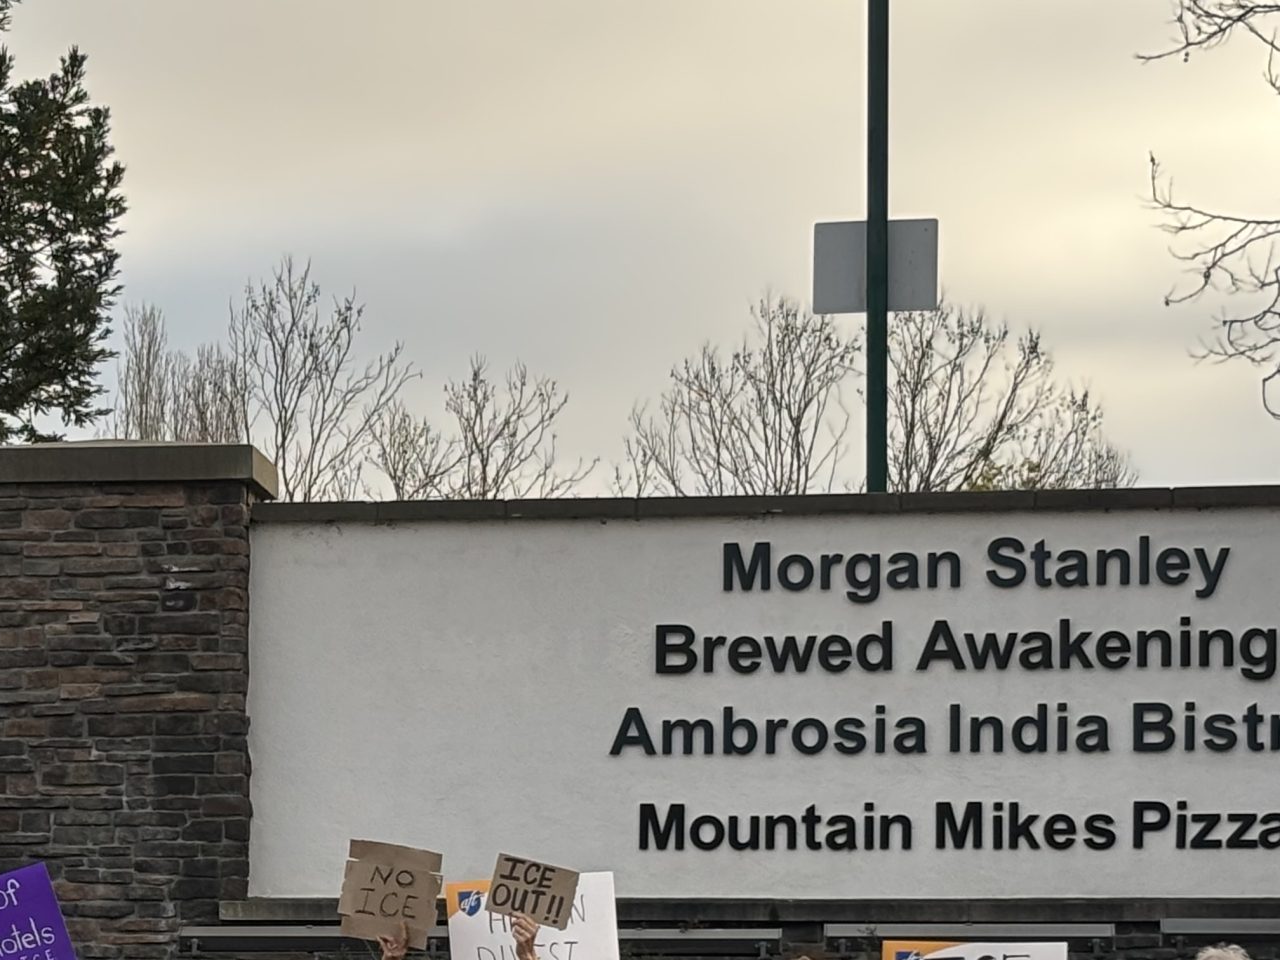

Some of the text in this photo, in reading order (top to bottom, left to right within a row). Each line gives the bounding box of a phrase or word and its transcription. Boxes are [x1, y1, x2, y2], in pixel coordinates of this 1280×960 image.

[723, 535, 1231, 604] Morgan Stanley
[655, 616, 1277, 681] Brewed Awakening
[609, 704, 927, 756] Ambrosia
[949, 702, 1110, 754] India
[638, 800, 1280, 851] Mountain Mikes Pizza
[369, 865, 415, 888] NO
[499, 857, 556, 889] ICE
[354, 887, 419, 919] ICE
[491, 883, 565, 925] OUT!!
